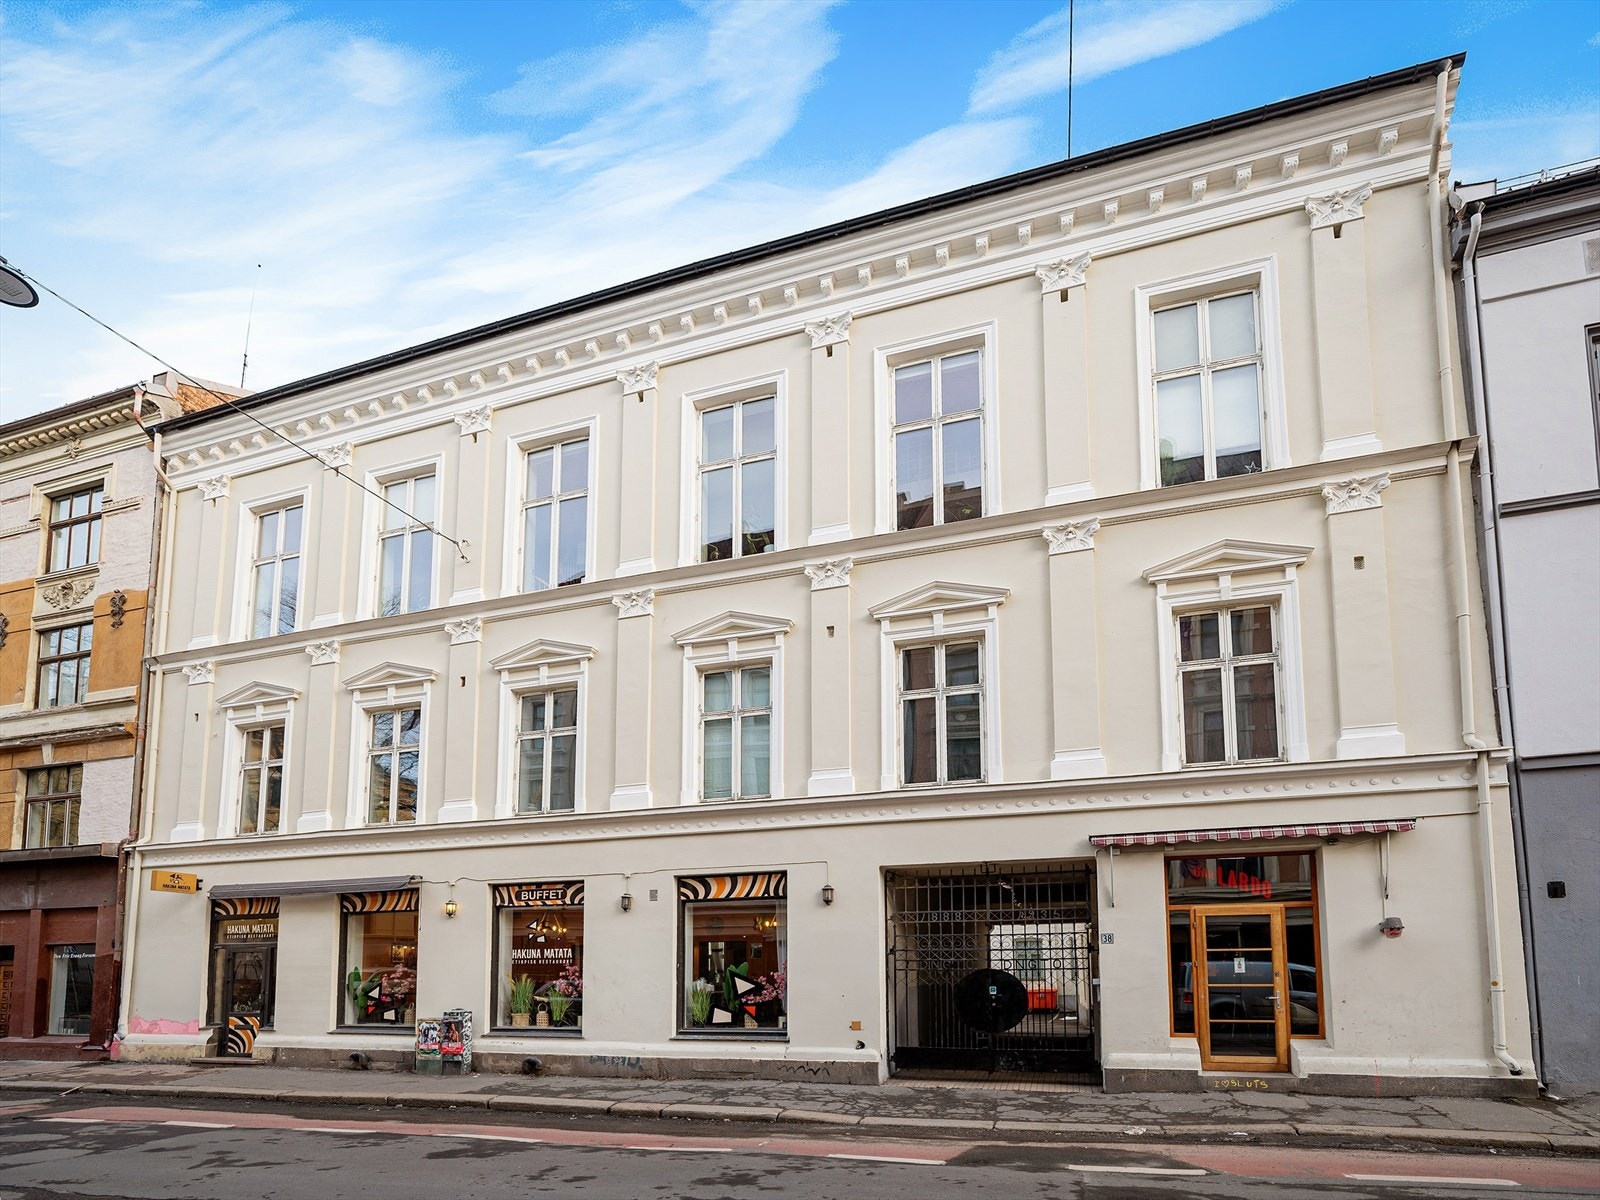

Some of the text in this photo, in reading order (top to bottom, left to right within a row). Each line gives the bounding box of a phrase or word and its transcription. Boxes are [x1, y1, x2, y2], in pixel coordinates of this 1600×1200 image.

[1217, 866, 1272, 899] LARDO
[521, 890, 563, 900] BUFFET
[921, 911, 963, 921] 1888
[227, 923, 274, 934] HAKUNA MATATA
[1103, 934, 1112, 943] 38
[512, 948, 573, 958] HAKUNA MATATA
